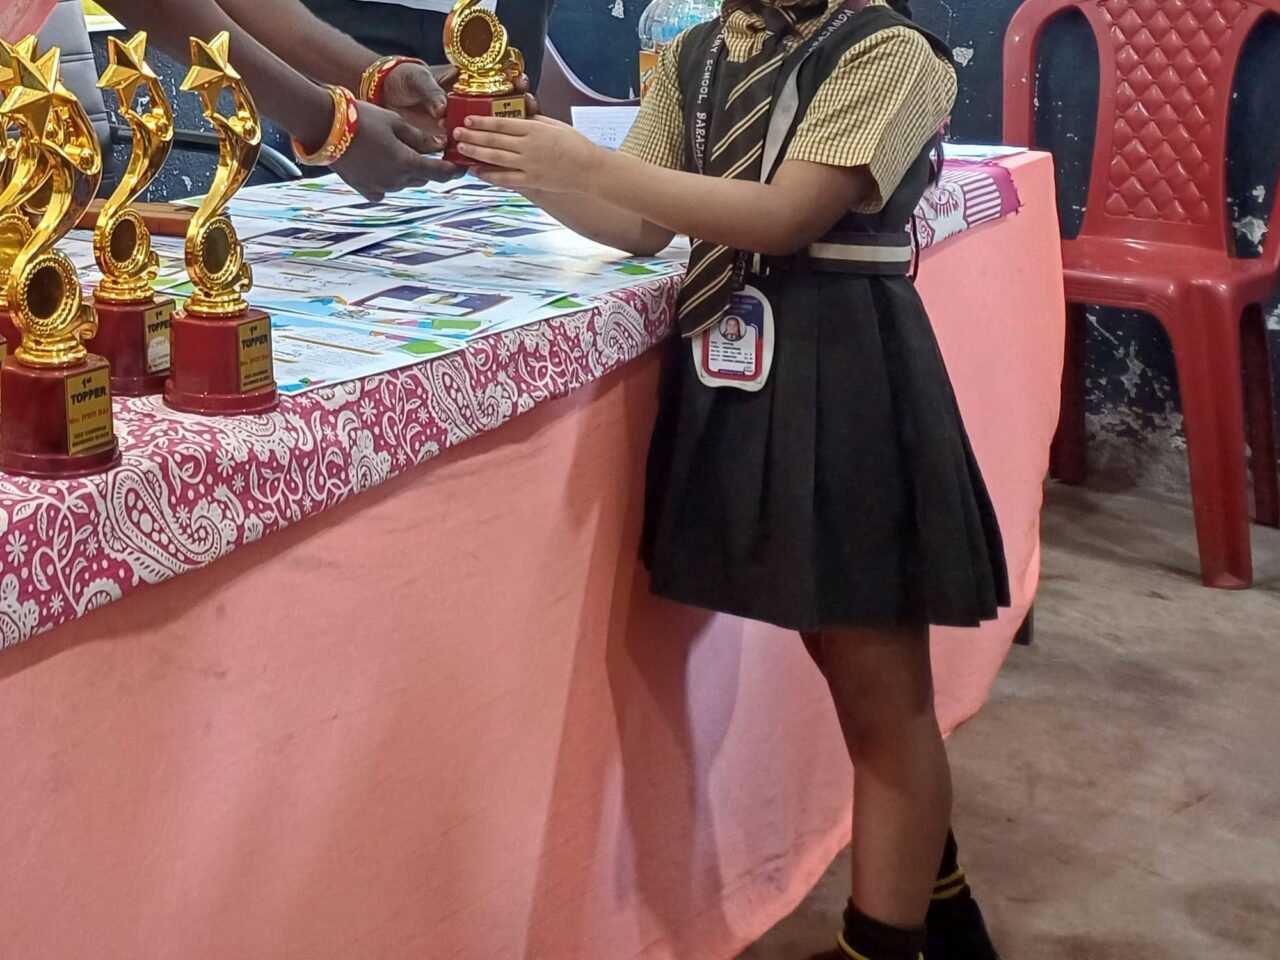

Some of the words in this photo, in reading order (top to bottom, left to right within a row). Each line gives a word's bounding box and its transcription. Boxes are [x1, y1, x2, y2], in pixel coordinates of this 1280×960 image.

[696, 59, 714, 105] SCHOOL,
[241, 333, 268, 350] TOPPER
[81, 376, 93, 389] 1st
[70, 385, 107, 406] TOPPER
